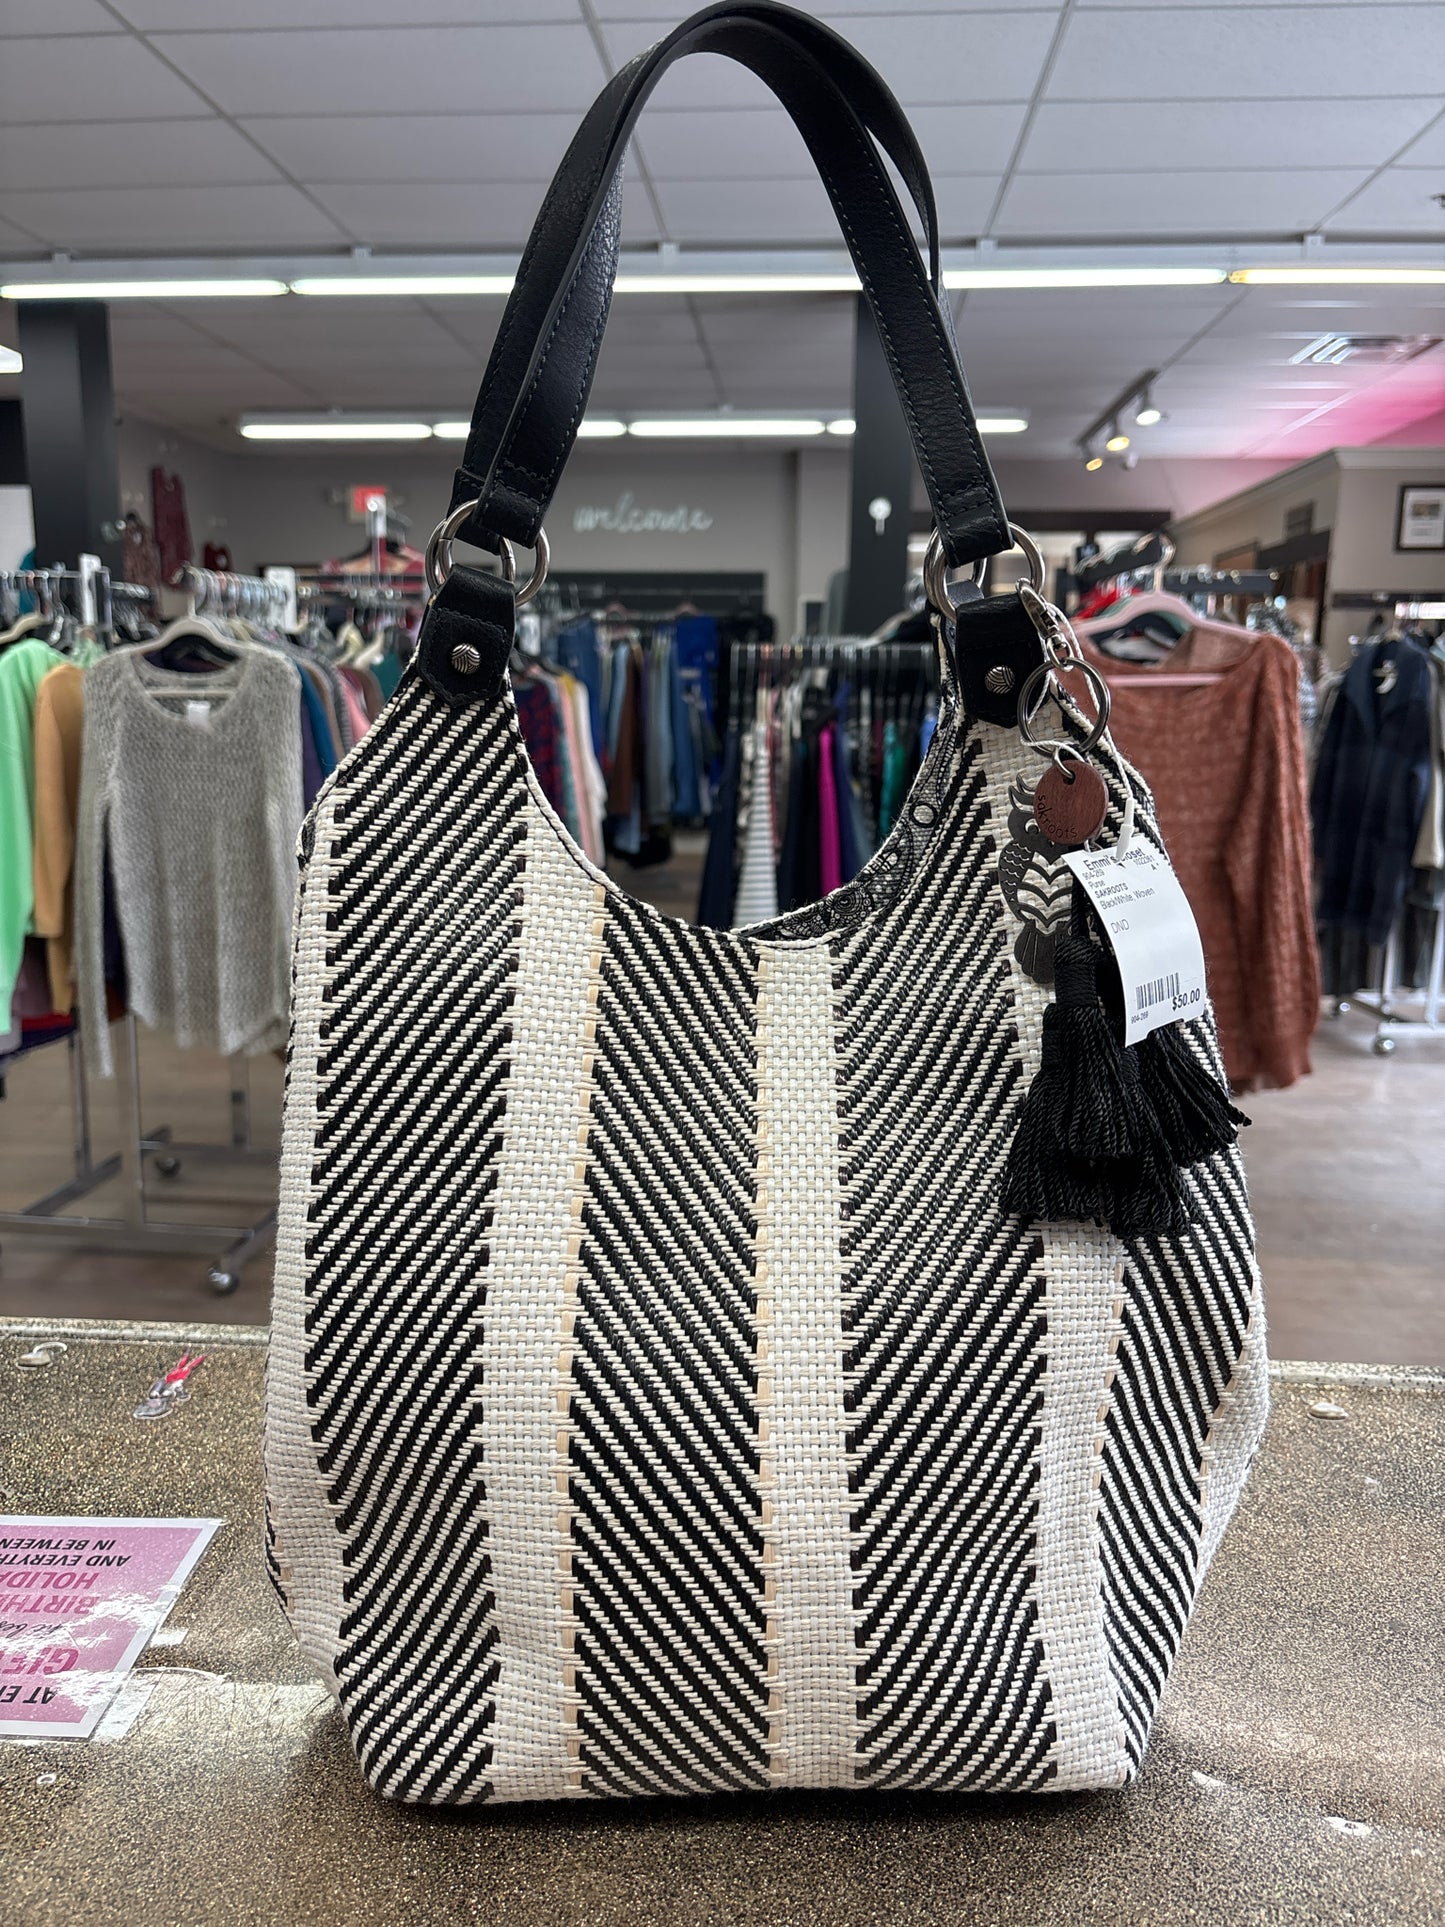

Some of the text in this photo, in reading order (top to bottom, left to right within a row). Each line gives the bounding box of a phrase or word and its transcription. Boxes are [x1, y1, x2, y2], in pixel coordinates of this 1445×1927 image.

[573, 490, 713, 533] welcome
[1037, 795, 1078, 838] sakroots
[1083, 854, 1118, 871] Emmi's
[1094, 882, 1129, 899] SAKROOTS
[1110, 918, 1130, 934] DND
[1172, 988, 1201, 1011] $50.00
[0, 1538, 117, 1551] IN BETWEEN
[85, 1554, 131, 1567] AND
[22, 1687, 57, 1705] AT
